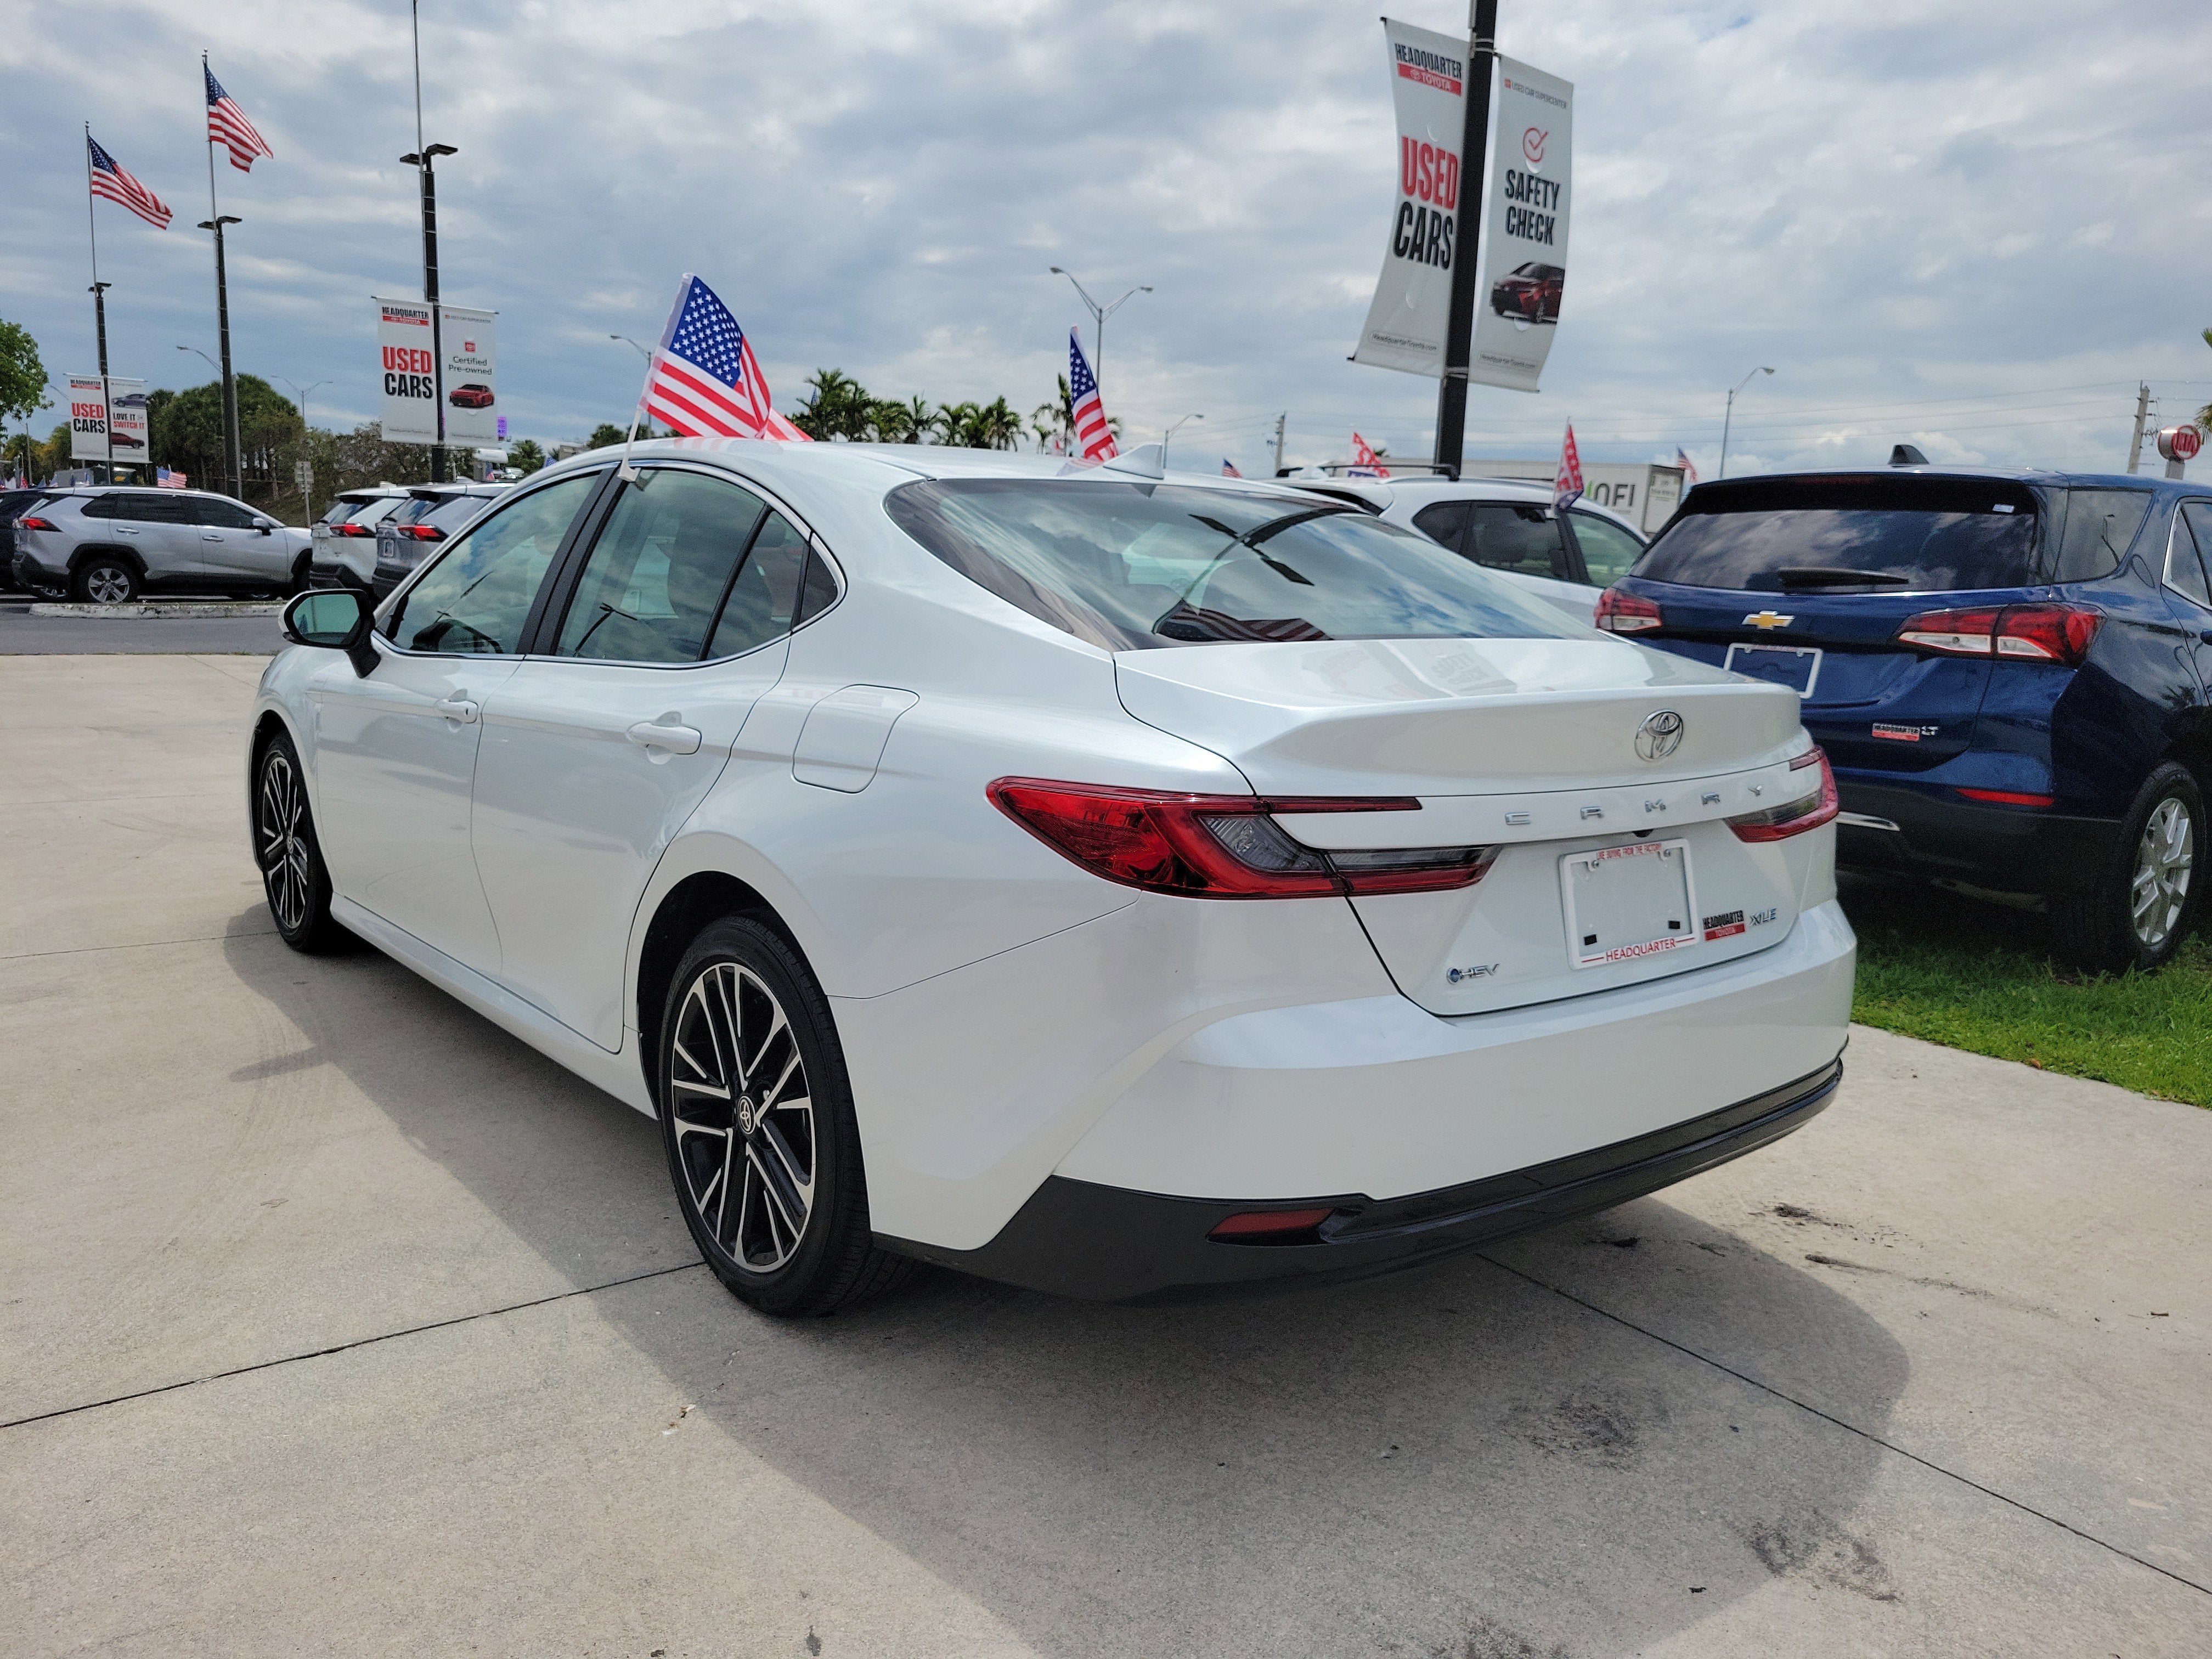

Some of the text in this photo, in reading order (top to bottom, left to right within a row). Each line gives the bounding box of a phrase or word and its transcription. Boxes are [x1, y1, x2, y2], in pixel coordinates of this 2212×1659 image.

[1394, 43, 1462, 81] HEADQUARTER
[1420, 72, 1451, 92] TOYOTA
[1401, 136, 1458, 210] USED
[1504, 169, 1560, 211] SAFETY
[1393, 201, 1453, 270] CARS
[1505, 206, 1555, 246] CHECK
[382, 306, 429, 319] HEADQUARTER
[382, 346, 432, 374] USED
[453, 356, 487, 366] Certified
[385, 373, 433, 399] CARS
[71, 402, 104, 419] USED
[113, 412, 128, 421] LOVE
[73, 418, 105, 434] CARS
[114, 421, 138, 429] SWITCH
[1505, 785, 1763, 825] CAMRY
[1702, 910, 1744, 929] HEADQUARTER
[1750, 907, 1777, 927] XLE
[1605, 938, 1676, 961] HEADQUARTER
